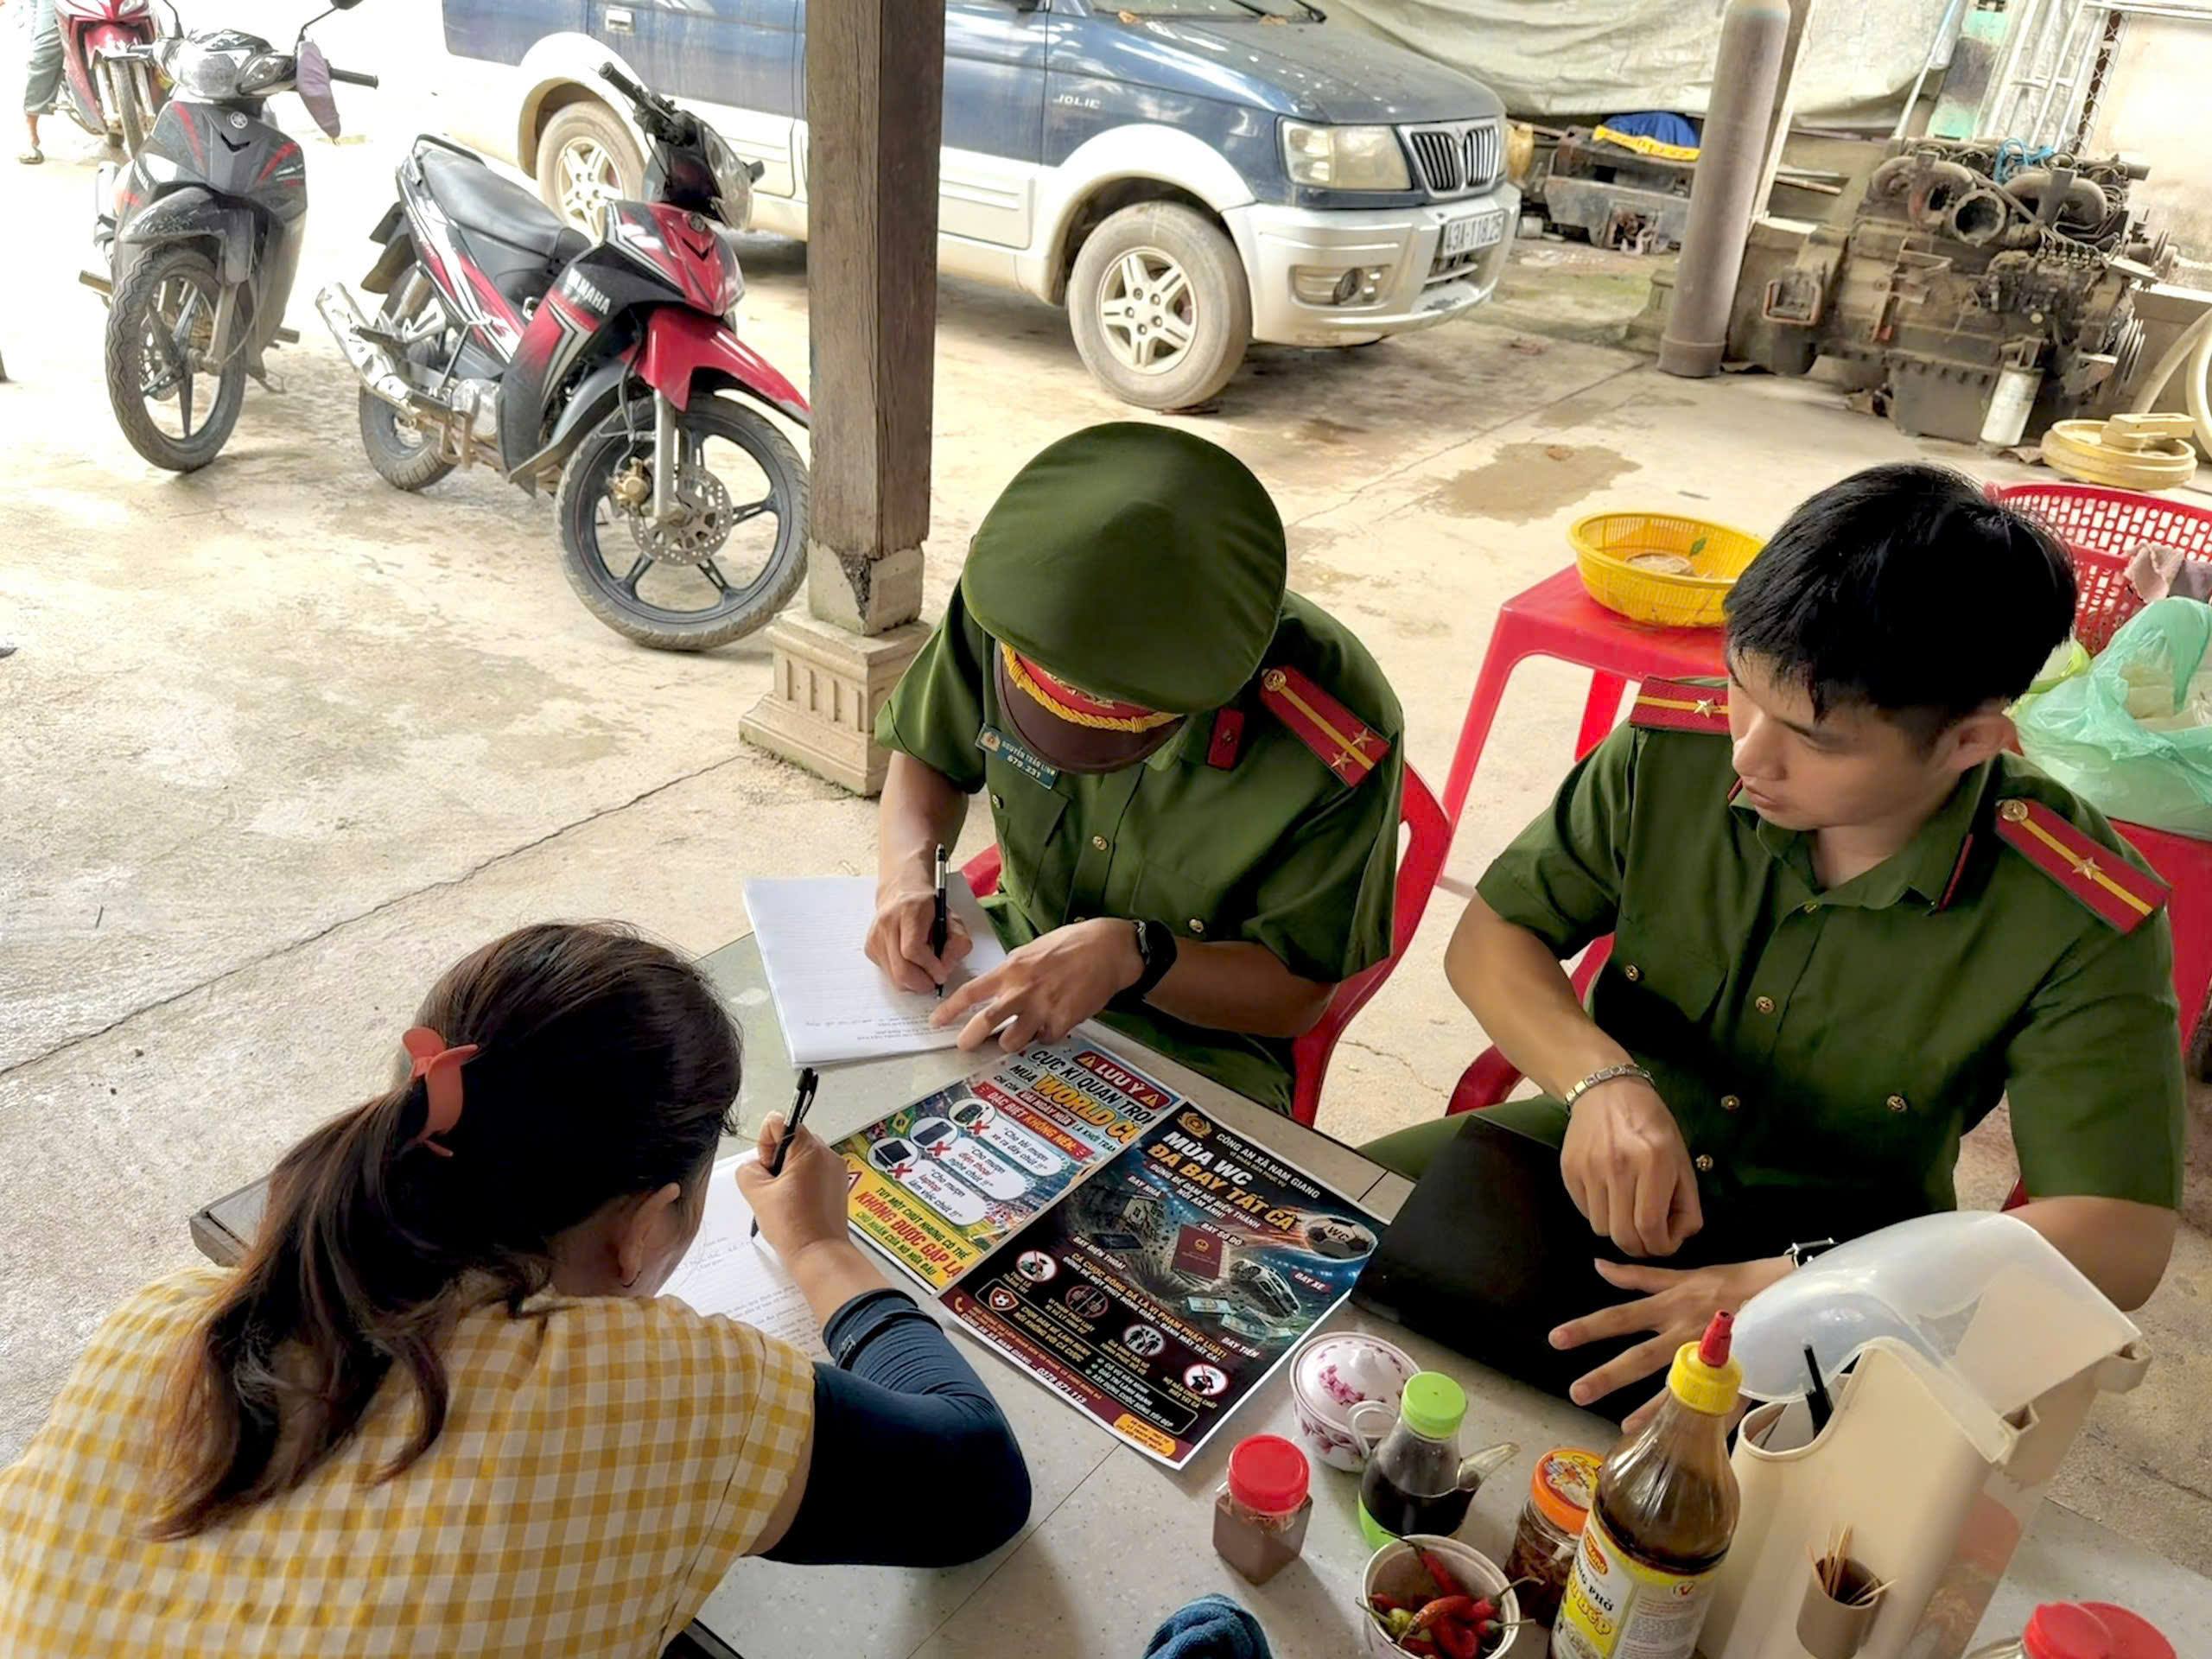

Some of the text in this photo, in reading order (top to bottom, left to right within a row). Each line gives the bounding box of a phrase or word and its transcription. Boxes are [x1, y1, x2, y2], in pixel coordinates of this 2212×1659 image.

[1052, 93, 1101, 110] JOLIE
[1008, 1064, 1037, 1082] MÙA
[1028, 1073, 1120, 1129] WORLD
[1027, 1049, 1065, 1071] CỰC
[1058, 1064, 1086, 1080] KÌ
[1077, 1077, 1122, 1103] QUAN
[1094, 1063, 1145, 1094] LƯU Ý
[1022, 1114, 1058, 1137] KHÔNG
[918, 1173, 942, 1192] laptop
[1162, 1131, 1252, 1185] MÙA WC
[1216, 1133, 1319, 1198] CÔNG AN XÃ NAM GIANG
[1179, 1162, 1227, 1189] BAY
[1226, 1182, 1268, 1212] TẤT
[1264, 1208, 1300, 1232] CẢ
[855, 1191, 964, 1278] KHÔNG ĐƯỢC GẶP LẠ
[1327, 1226, 1349, 1242] WC
